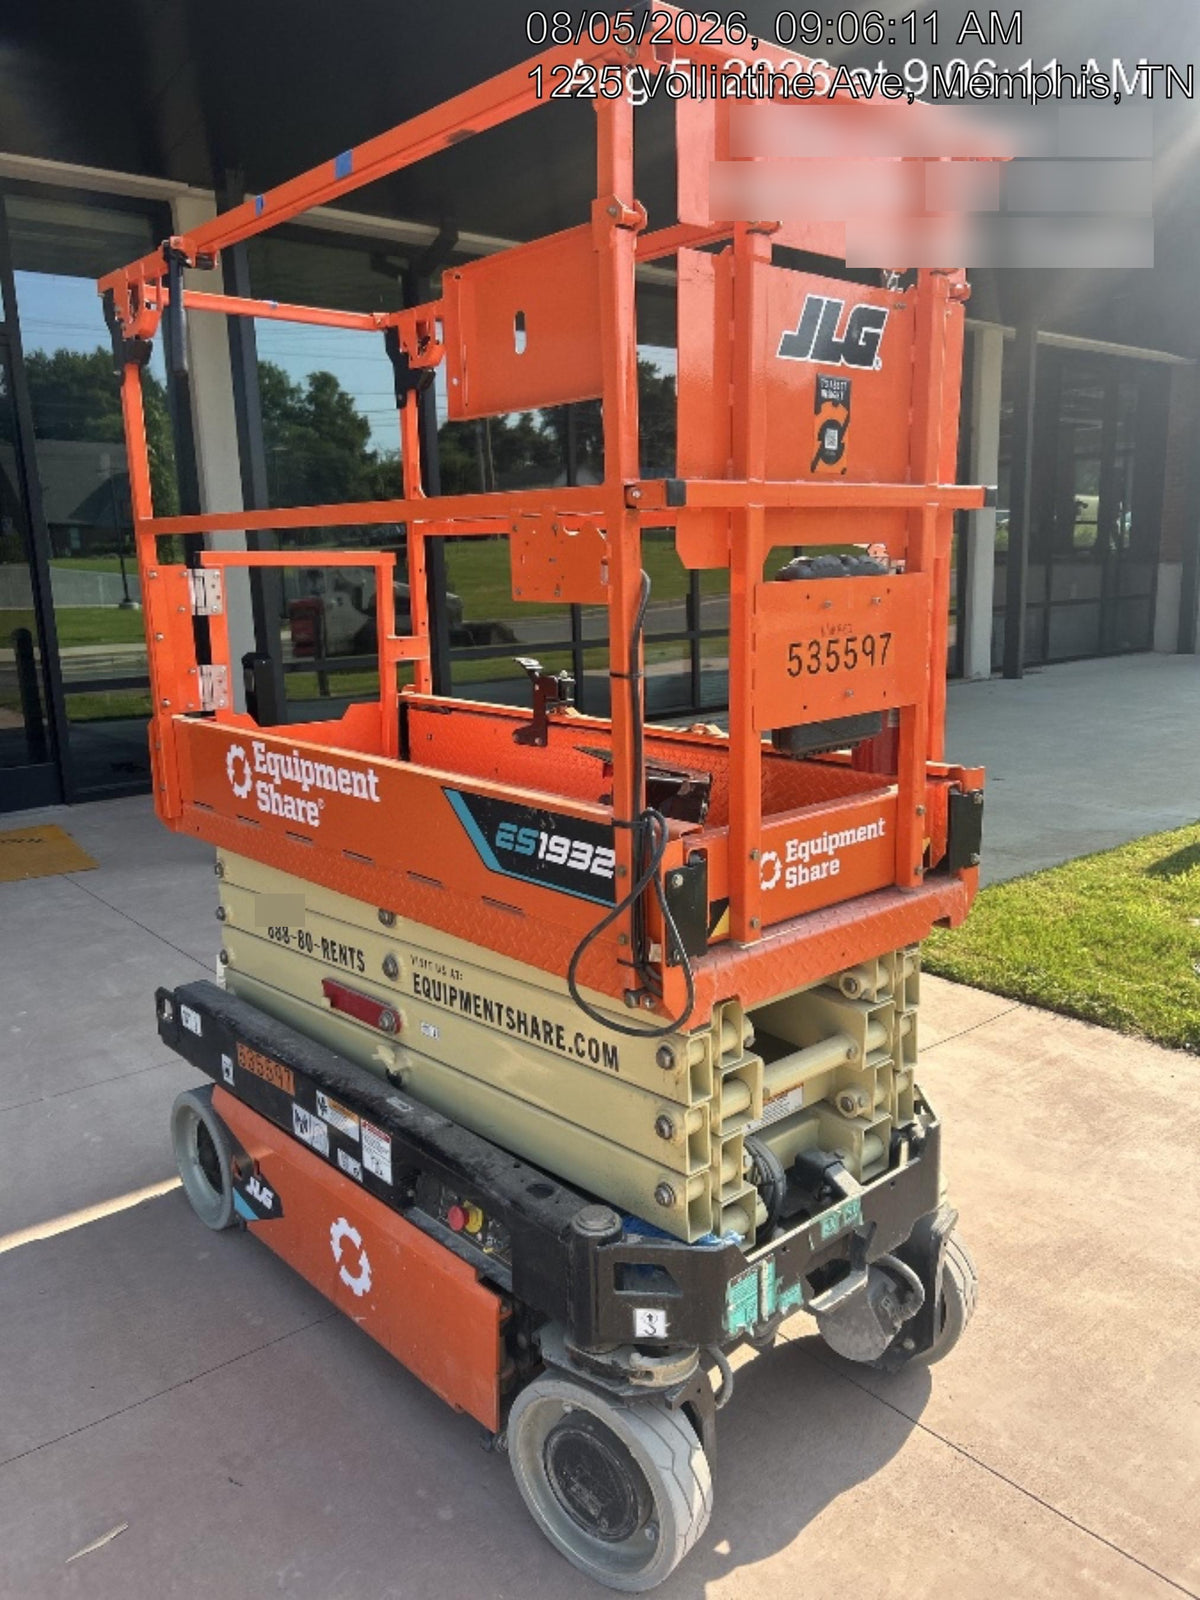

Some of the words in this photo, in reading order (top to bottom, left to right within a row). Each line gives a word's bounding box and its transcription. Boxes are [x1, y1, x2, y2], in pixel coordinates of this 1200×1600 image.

[776, 293, 890, 370] JLG
[787, 632, 892, 678] 535597
[251, 740, 380, 803] Equipment
[256, 781, 321, 827] Share
[495, 821, 616, 880] ES1932
[785, 817, 886, 863] Equipment
[785, 858, 840, 890] Share
[413, 971, 619, 1073] EQUIPMENTSHARE.COM
